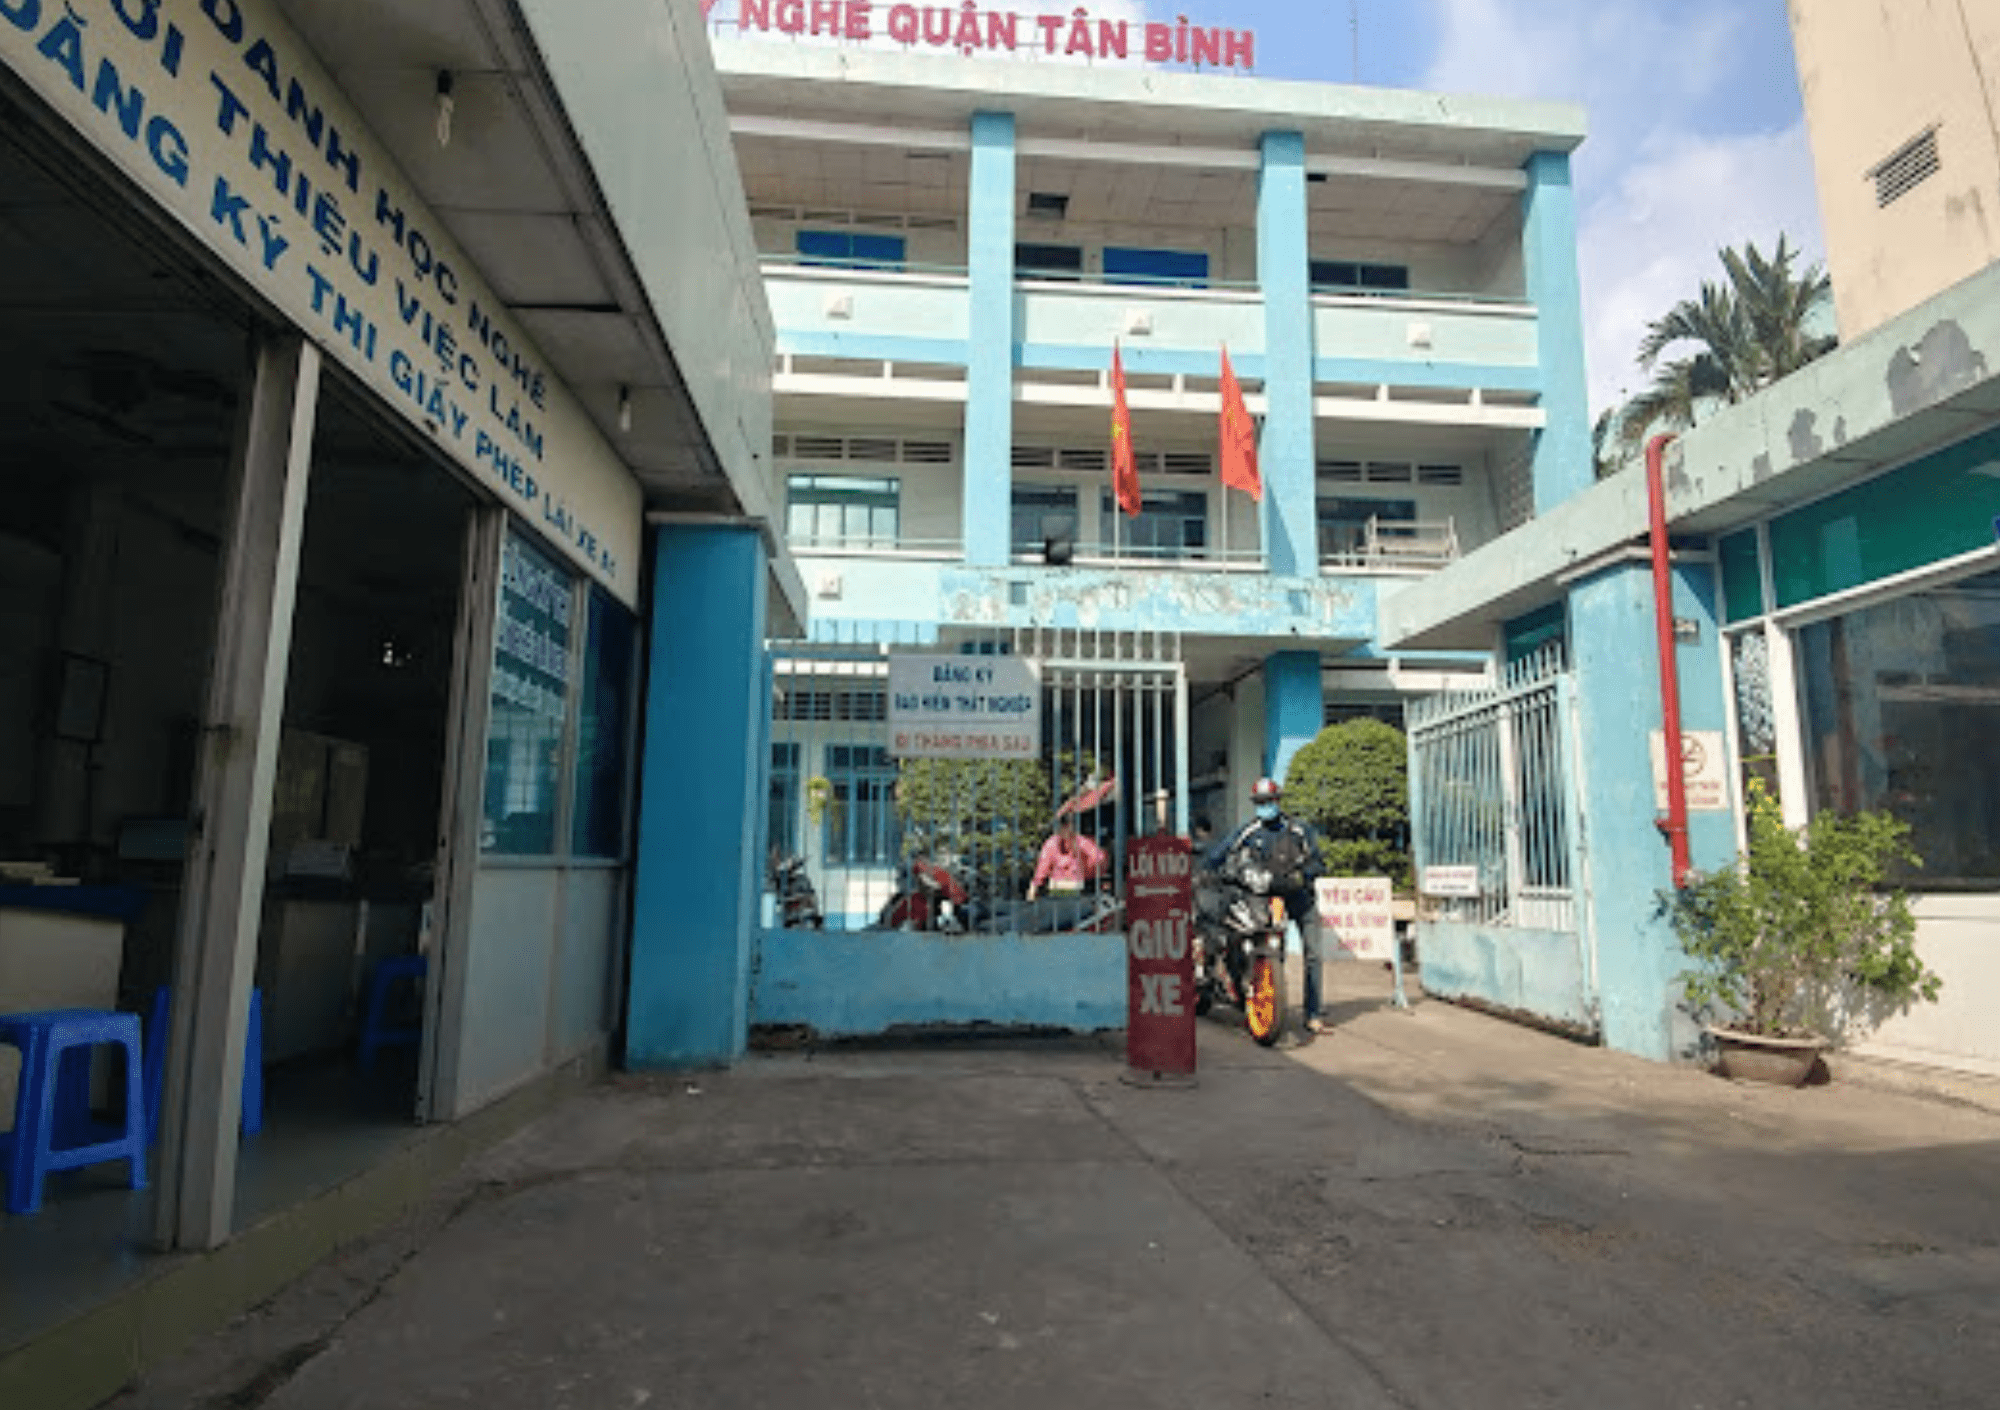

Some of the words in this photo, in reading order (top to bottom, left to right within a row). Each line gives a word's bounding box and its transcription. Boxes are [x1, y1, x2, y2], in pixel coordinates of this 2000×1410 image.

[888, 0, 1017, 56] QUẬN
[1036, 7, 1128, 59] TÂN
[1144, 13, 1255, 69] BÌNH
[210, 174, 290, 272] KÝ
[306, 262, 378, 362] THI
[211, 70, 379, 286] THIỆU
[395, 277, 480, 393] VIỆC
[376, 188, 457, 305] HỌC
[1129, 908, 1189, 960] GIỮ
[1139, 973, 1185, 1017] XE
